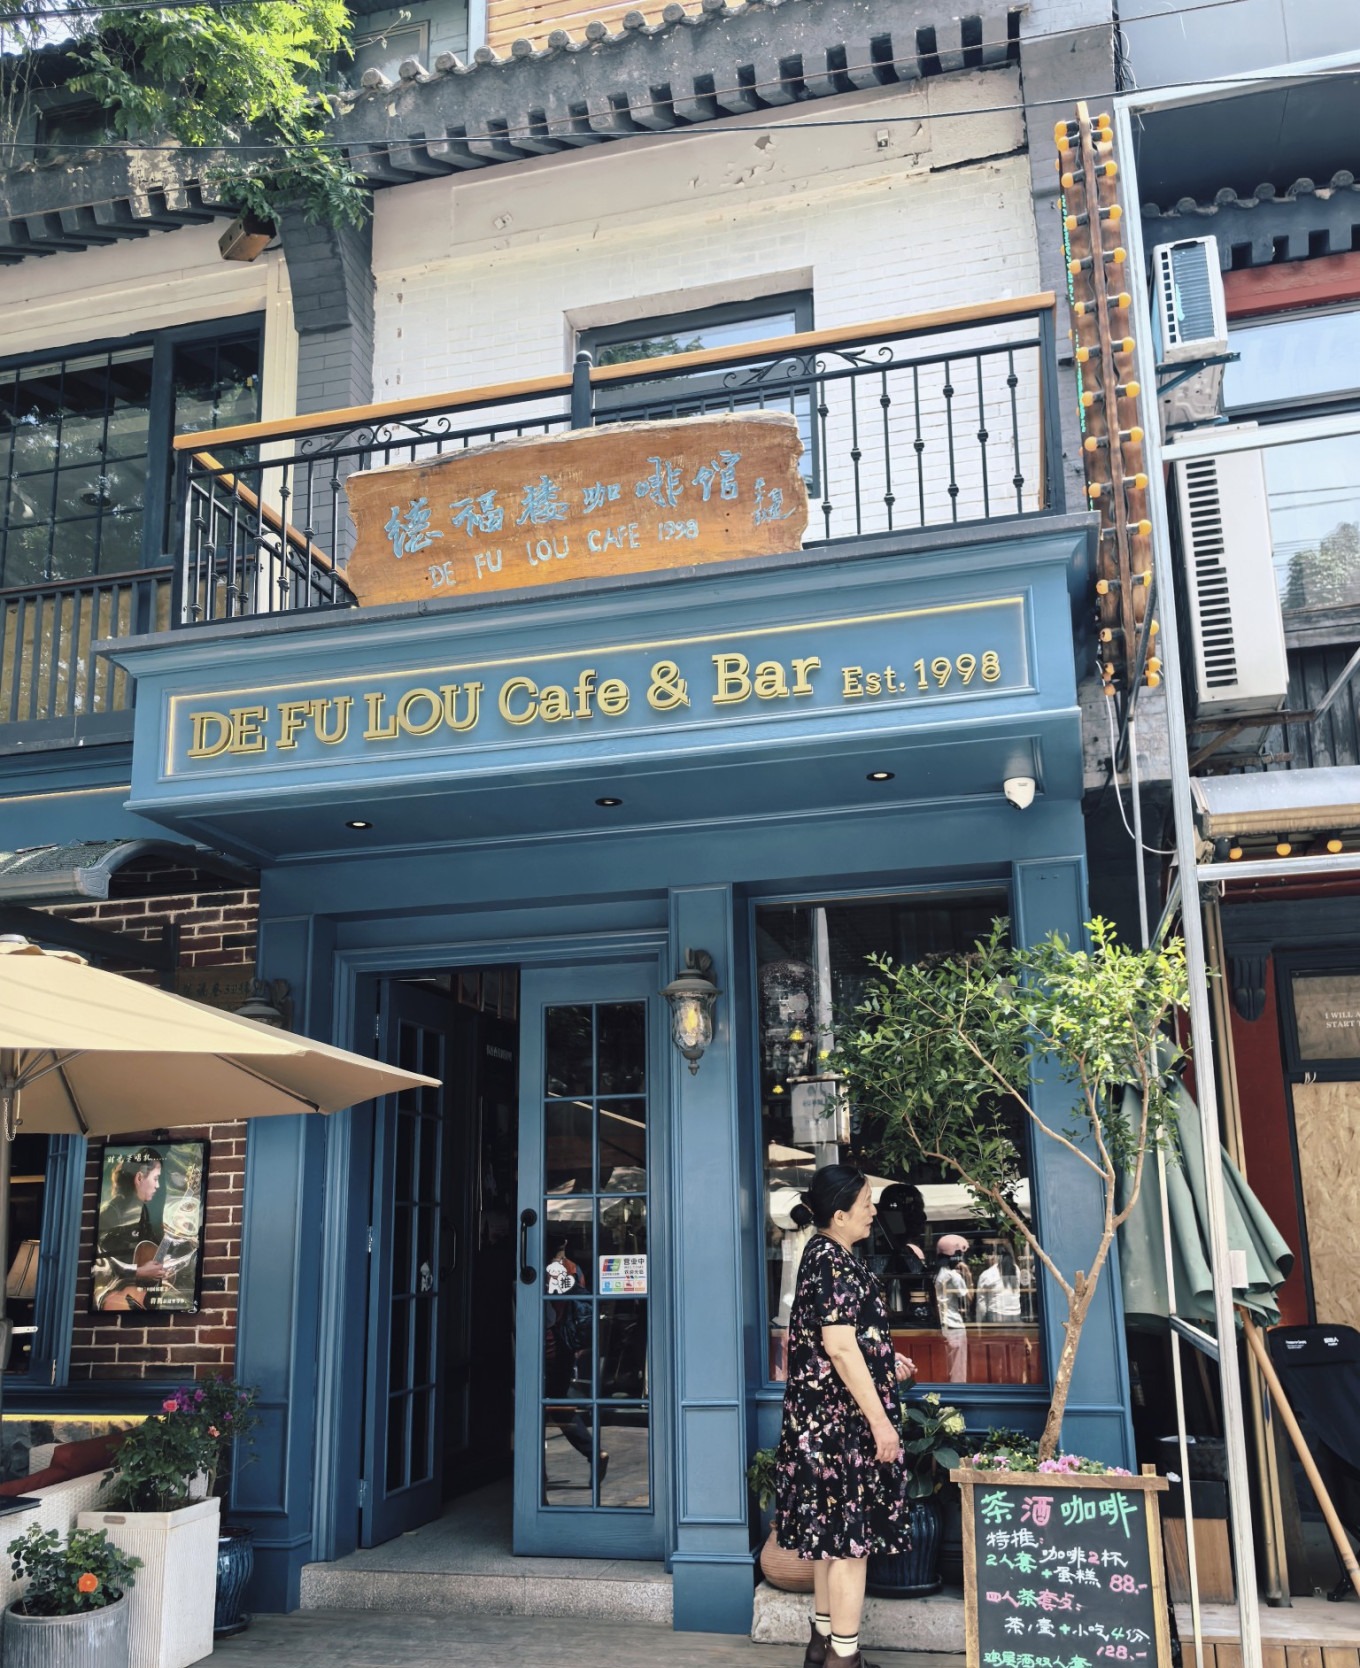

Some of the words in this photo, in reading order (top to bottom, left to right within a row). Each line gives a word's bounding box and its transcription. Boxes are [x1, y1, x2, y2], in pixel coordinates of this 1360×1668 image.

[427, 561, 457, 589] DE
[473, 549, 503, 580] FU
[526, 535, 570, 567] LOU
[587, 522, 641, 552] CAFE
[658, 519, 700, 541] 1998
[186, 705, 268, 759] DE
[275, 696, 354, 750] FU
[363, 681, 485, 741] LOU
[498, 669, 630, 725] Cafe
[646, 659, 691, 711] &
[711, 652, 822, 706] Bar
[841, 665, 907, 698] Est.
[914, 650, 1001, 691] 1998
[1330, 1011, 1354, 1019] WILL
[1326, 1020, 1355, 1028] START
[561, 1278, 572, 1289] 推
